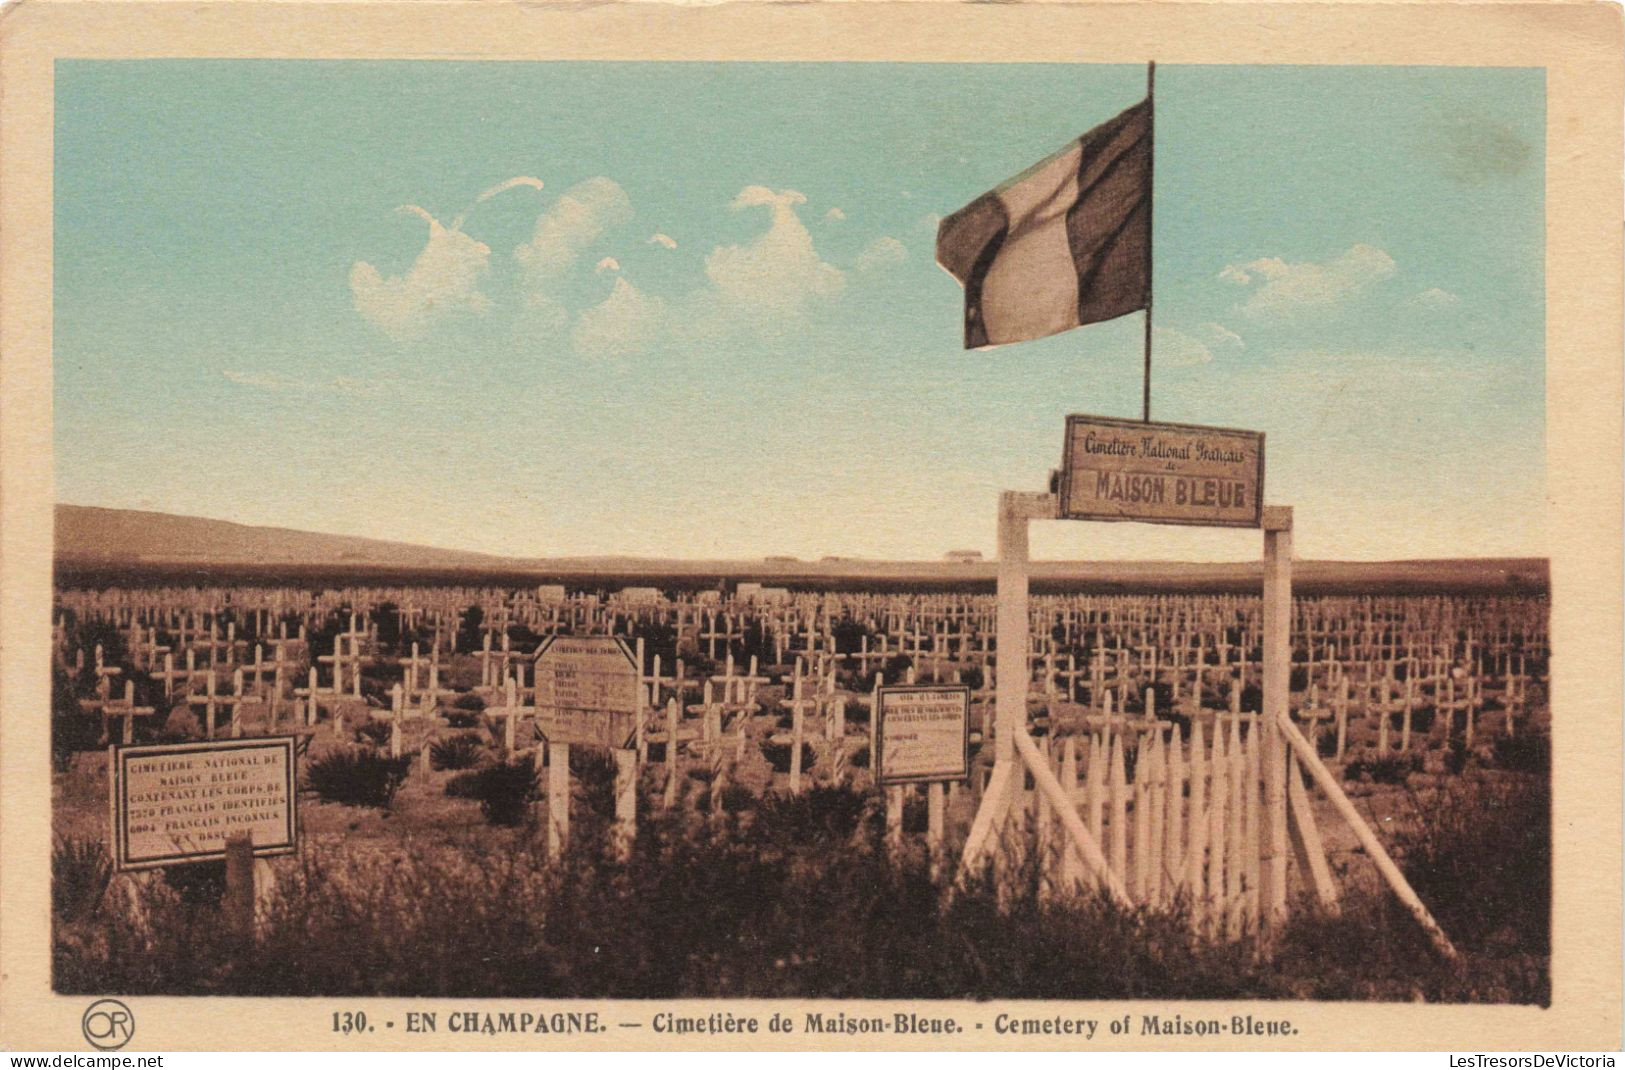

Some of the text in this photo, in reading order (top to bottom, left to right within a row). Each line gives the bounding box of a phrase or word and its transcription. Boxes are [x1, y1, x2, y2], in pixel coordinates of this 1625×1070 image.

[1138, 436, 1192, 460] National
[1196, 439, 1244, 466] Français
[1096, 471, 1246, 508] MAISON BLEUE
[203, 757, 259, 769] NATIONAL
[264, 755, 278, 765] DE
[160, 771, 248, 786] MAISON BLEUE
[129, 788, 197, 804] CONTENANT
[202, 787, 223, 798] LES
[226, 812, 279, 825] INCONNUS
